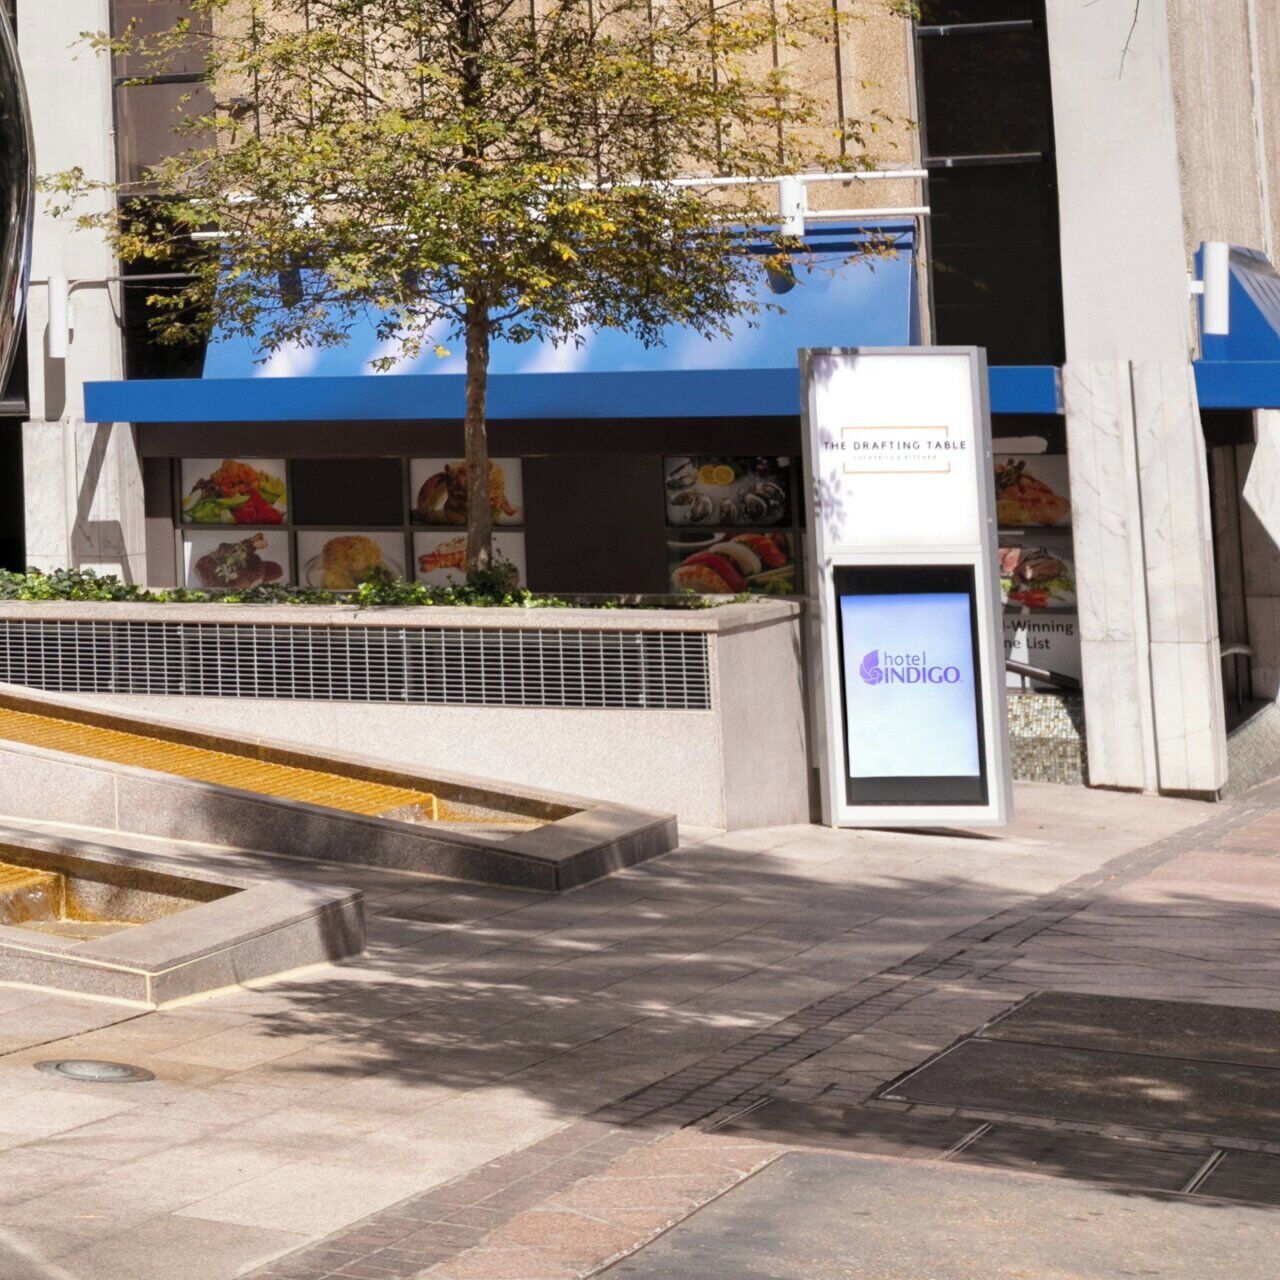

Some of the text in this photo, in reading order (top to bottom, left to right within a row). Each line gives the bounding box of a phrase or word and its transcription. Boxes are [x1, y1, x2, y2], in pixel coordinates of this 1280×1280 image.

[824, 440, 966, 451] THE DRAFTING TABLE
[1002, 620, 1074, 636] -Winning
[1026, 636, 1051, 650] List
[883, 650, 926, 666] hotel
[884, 666, 961, 684] INDIGO
